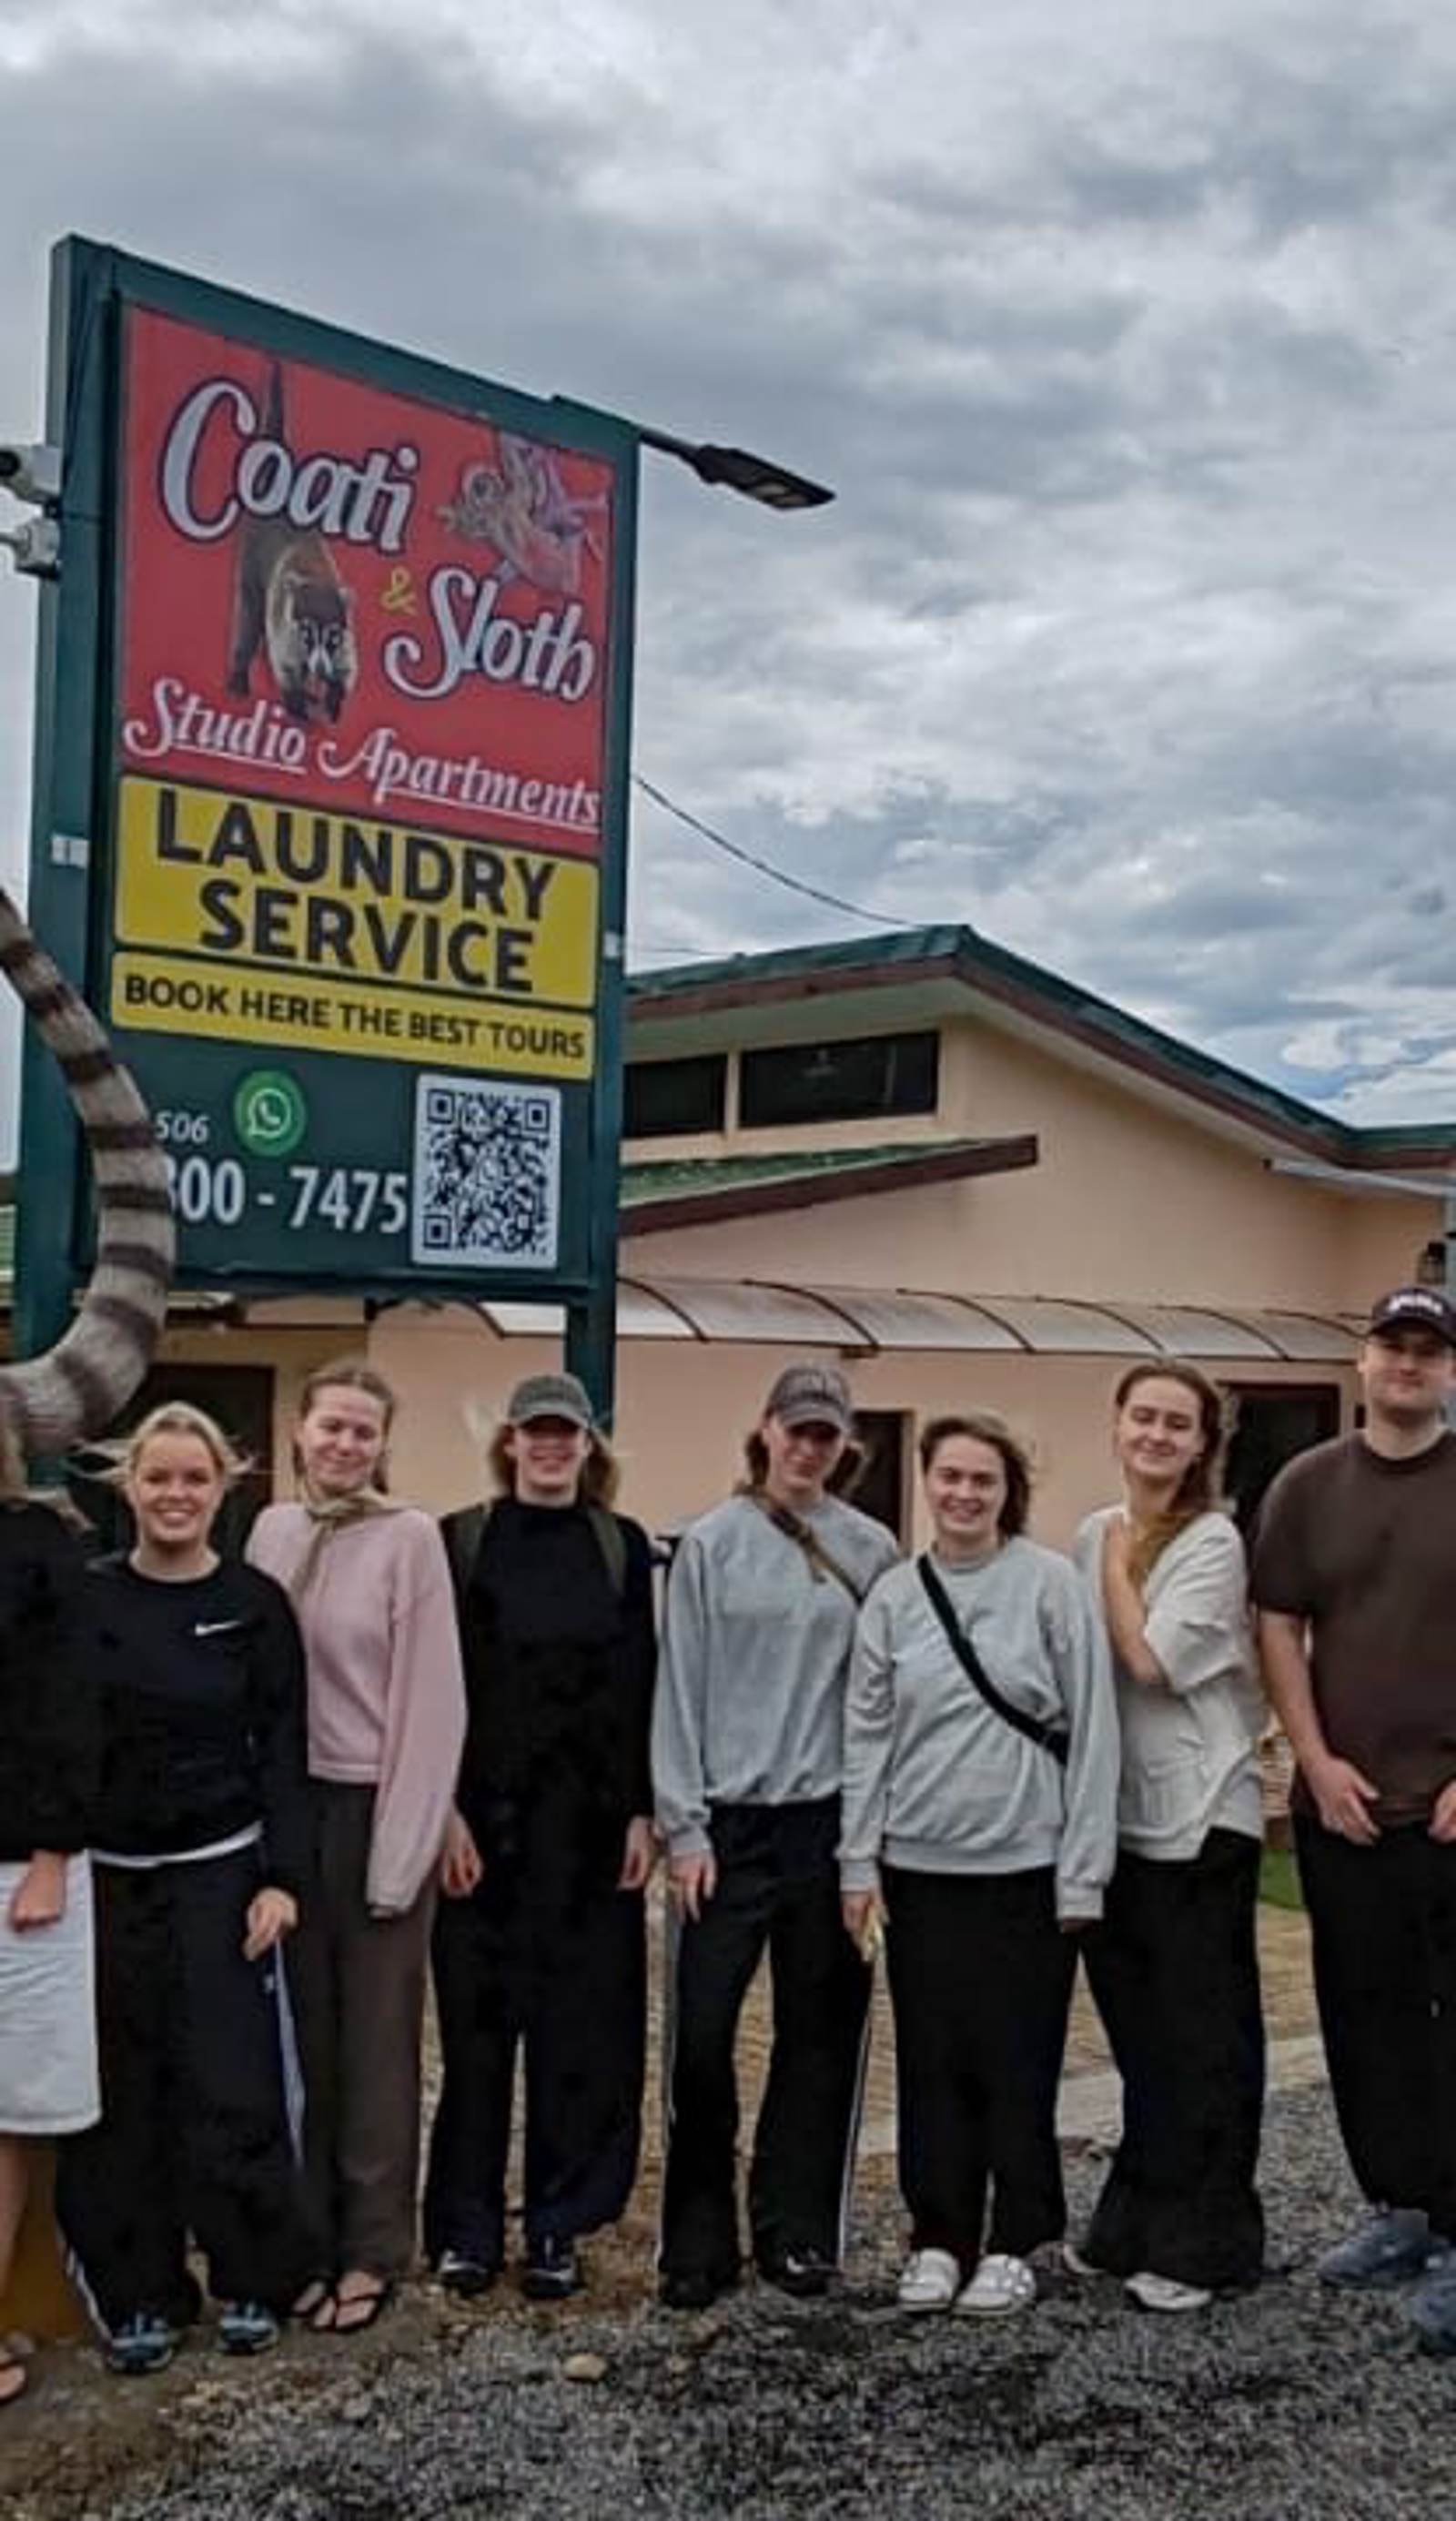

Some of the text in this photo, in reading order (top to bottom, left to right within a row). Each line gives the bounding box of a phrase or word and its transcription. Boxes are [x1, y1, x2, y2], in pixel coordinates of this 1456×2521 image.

[161, 377, 419, 553] Coati
[380, 567, 418, 615] &
[384, 567, 595, 700] Sloth
[124, 677, 601, 830] Studio Apartments
[157, 789, 557, 921] LAUNDRY
[199, 880, 533, 992] SERVICE
[126, 975, 584, 1058] BOOK HERE THE BEST TOURS
[155, 1111, 209, 1143] 506
[289, 1165, 408, 1233] 7475
